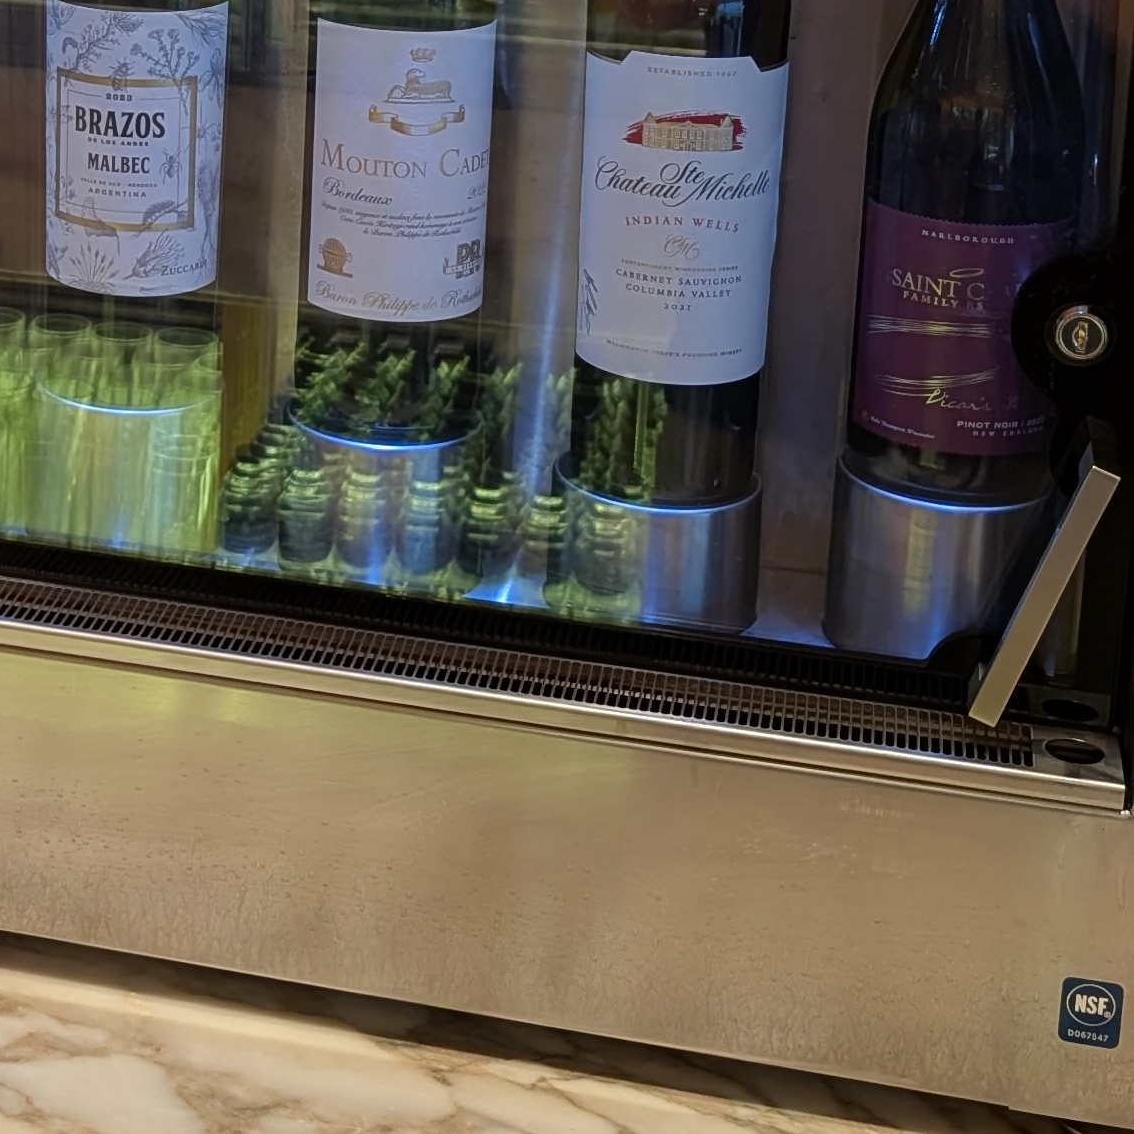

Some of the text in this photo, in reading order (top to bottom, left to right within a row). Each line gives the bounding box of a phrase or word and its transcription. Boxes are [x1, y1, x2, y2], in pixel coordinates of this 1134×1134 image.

[647, 66, 713, 77] ESTABLISHED
[74, 105, 166, 139] BRAZOS
[100, 138, 117, 146] LOS
[87, 152, 151, 174] MALBEC
[320, 137, 429, 179] MOUTON
[594, 155, 682, 199] Chateau
[659, 159, 705, 185] Ste
[88, 187, 148, 198] ARGENTINA
[322, 176, 394, 207] Bordeaux
[624, 215, 740, 233] INDIAN WELLS
[921, 229, 1015, 245] MARLBOROUGH
[615, 268, 743, 287] CABERNET SAUVIGNON
[891, 268, 962, 298] SAINT
[316, 280, 359, 306] Baron
[362, 291, 421, 316] Philippe
[422, 296, 438, 311] de
[625, 283, 732, 299] COLUMBIA VALLEY
[902, 290, 959, 309] FAMILY
[663, 303, 692, 312] 2021
[956, 420, 992, 429] PINOT
[993, 421, 1019, 430] NOIR
[1074, 993, 1110, 1017] NSF
